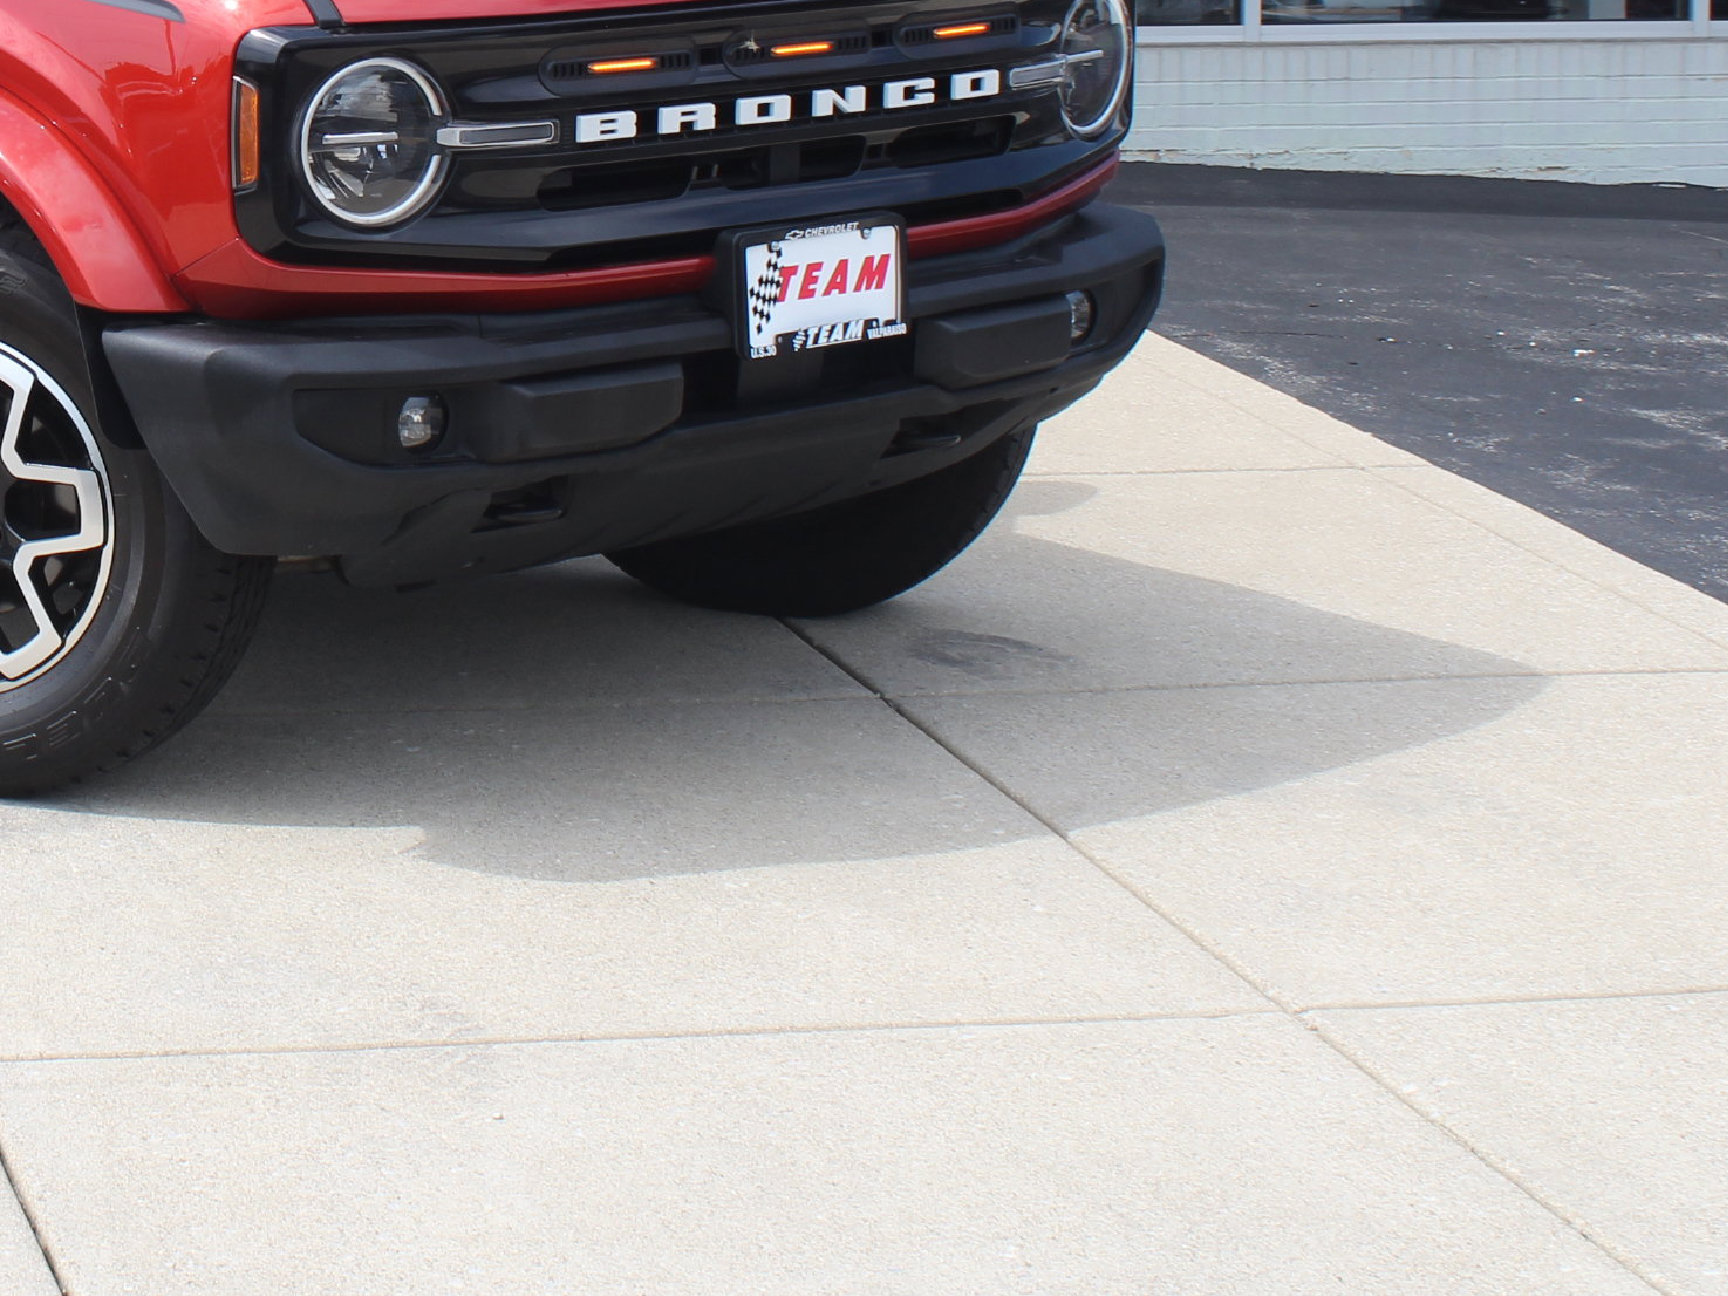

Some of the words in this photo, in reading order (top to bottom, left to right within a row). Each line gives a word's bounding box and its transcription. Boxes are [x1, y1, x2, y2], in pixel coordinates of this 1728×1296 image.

[575, 69, 1000, 144] BRONCO
[804, 221, 860, 239] CHEVROLET
[777, 253, 892, 303] TEAM
[806, 319, 865, 348] TEAM
